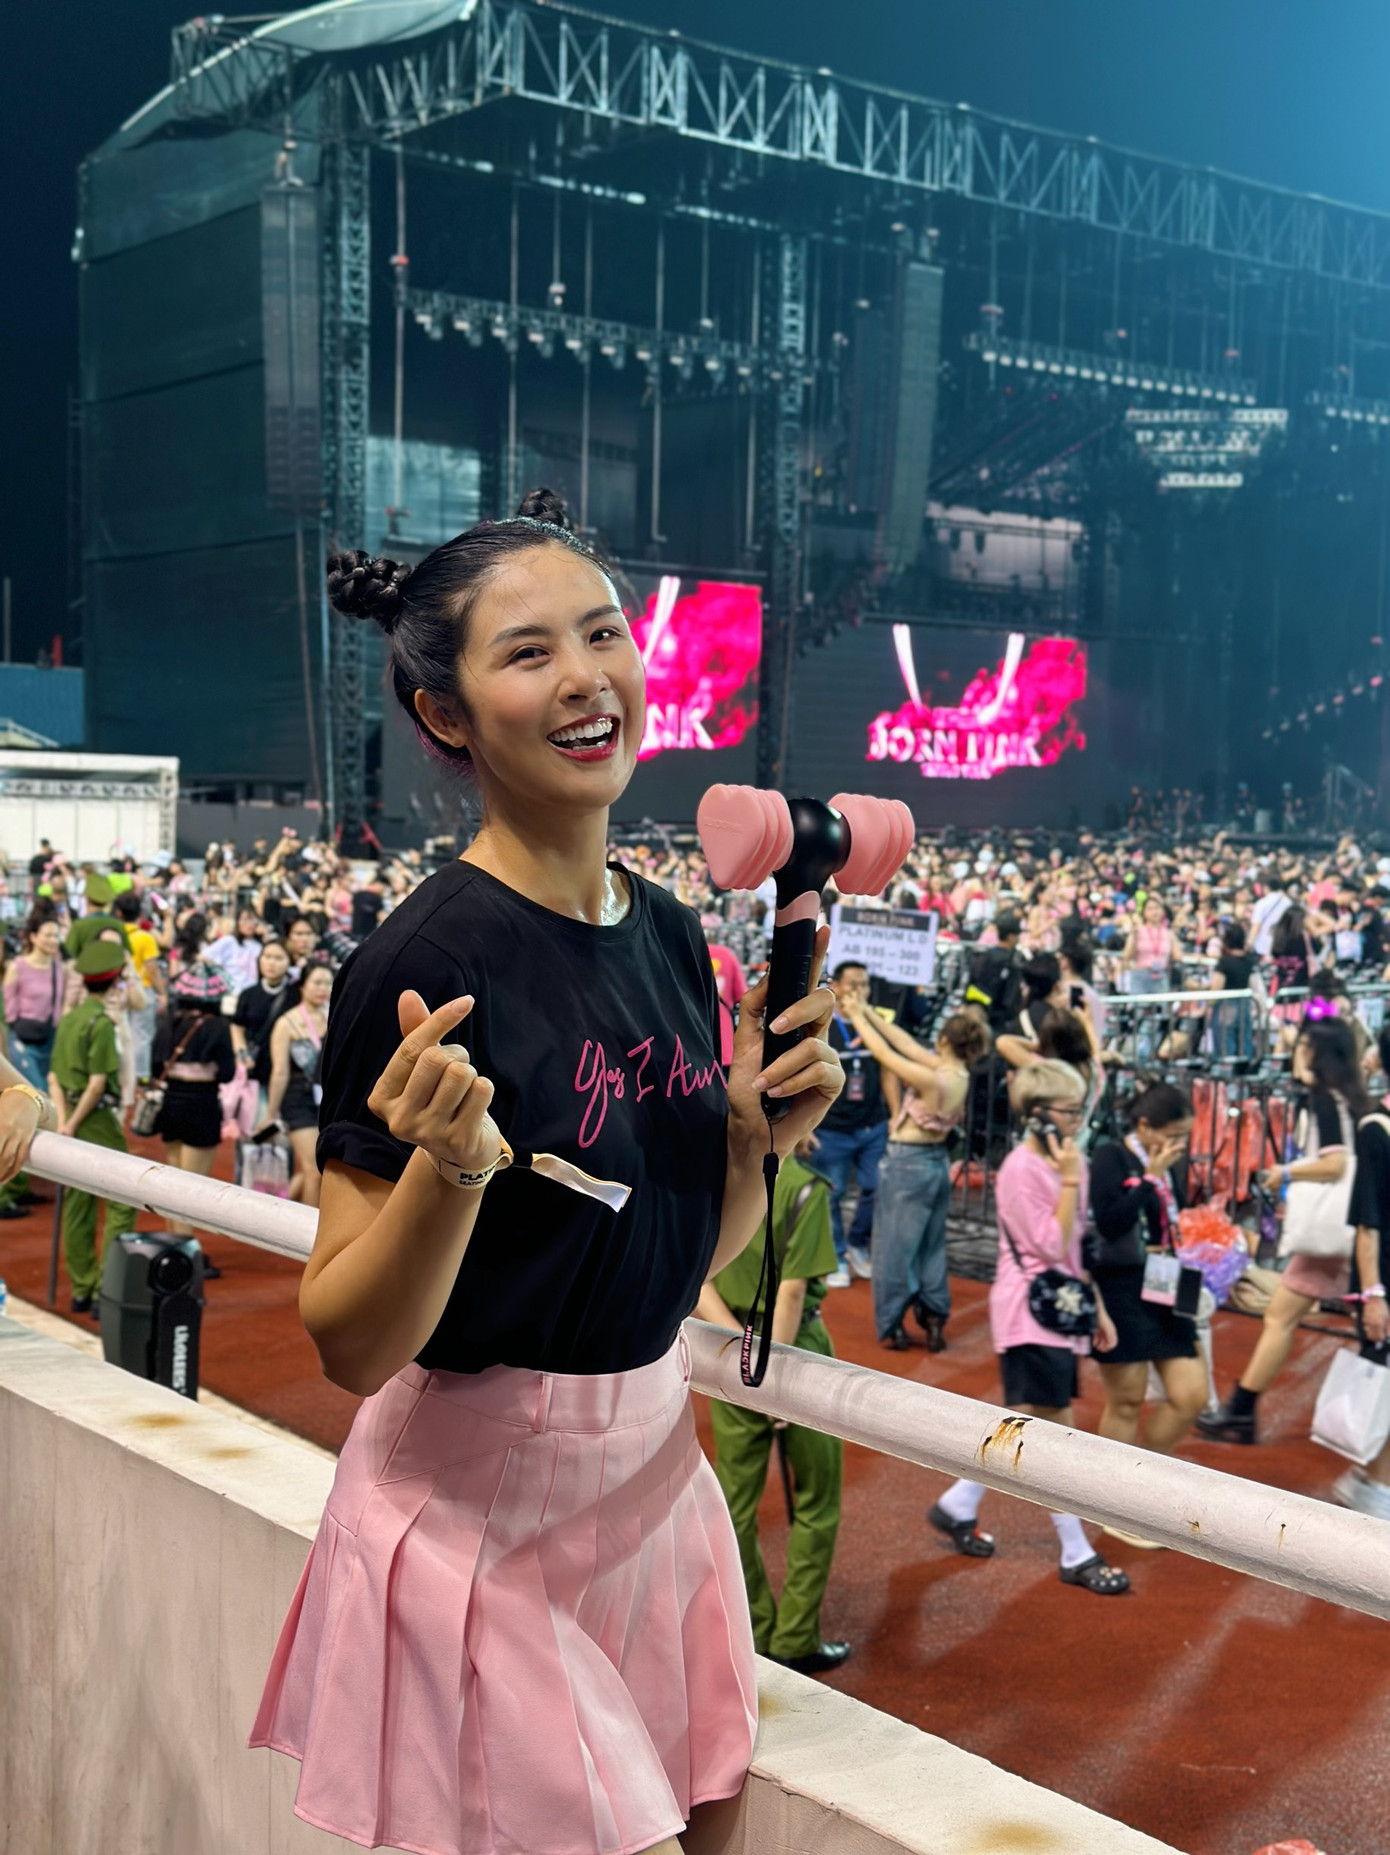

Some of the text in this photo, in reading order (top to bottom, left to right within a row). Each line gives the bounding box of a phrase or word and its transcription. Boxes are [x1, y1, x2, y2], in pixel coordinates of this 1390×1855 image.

[838, 925, 904, 941] PLATINUM
[575, 1039, 625, 1148] Yes
[627, 1036, 654, 1102] I
